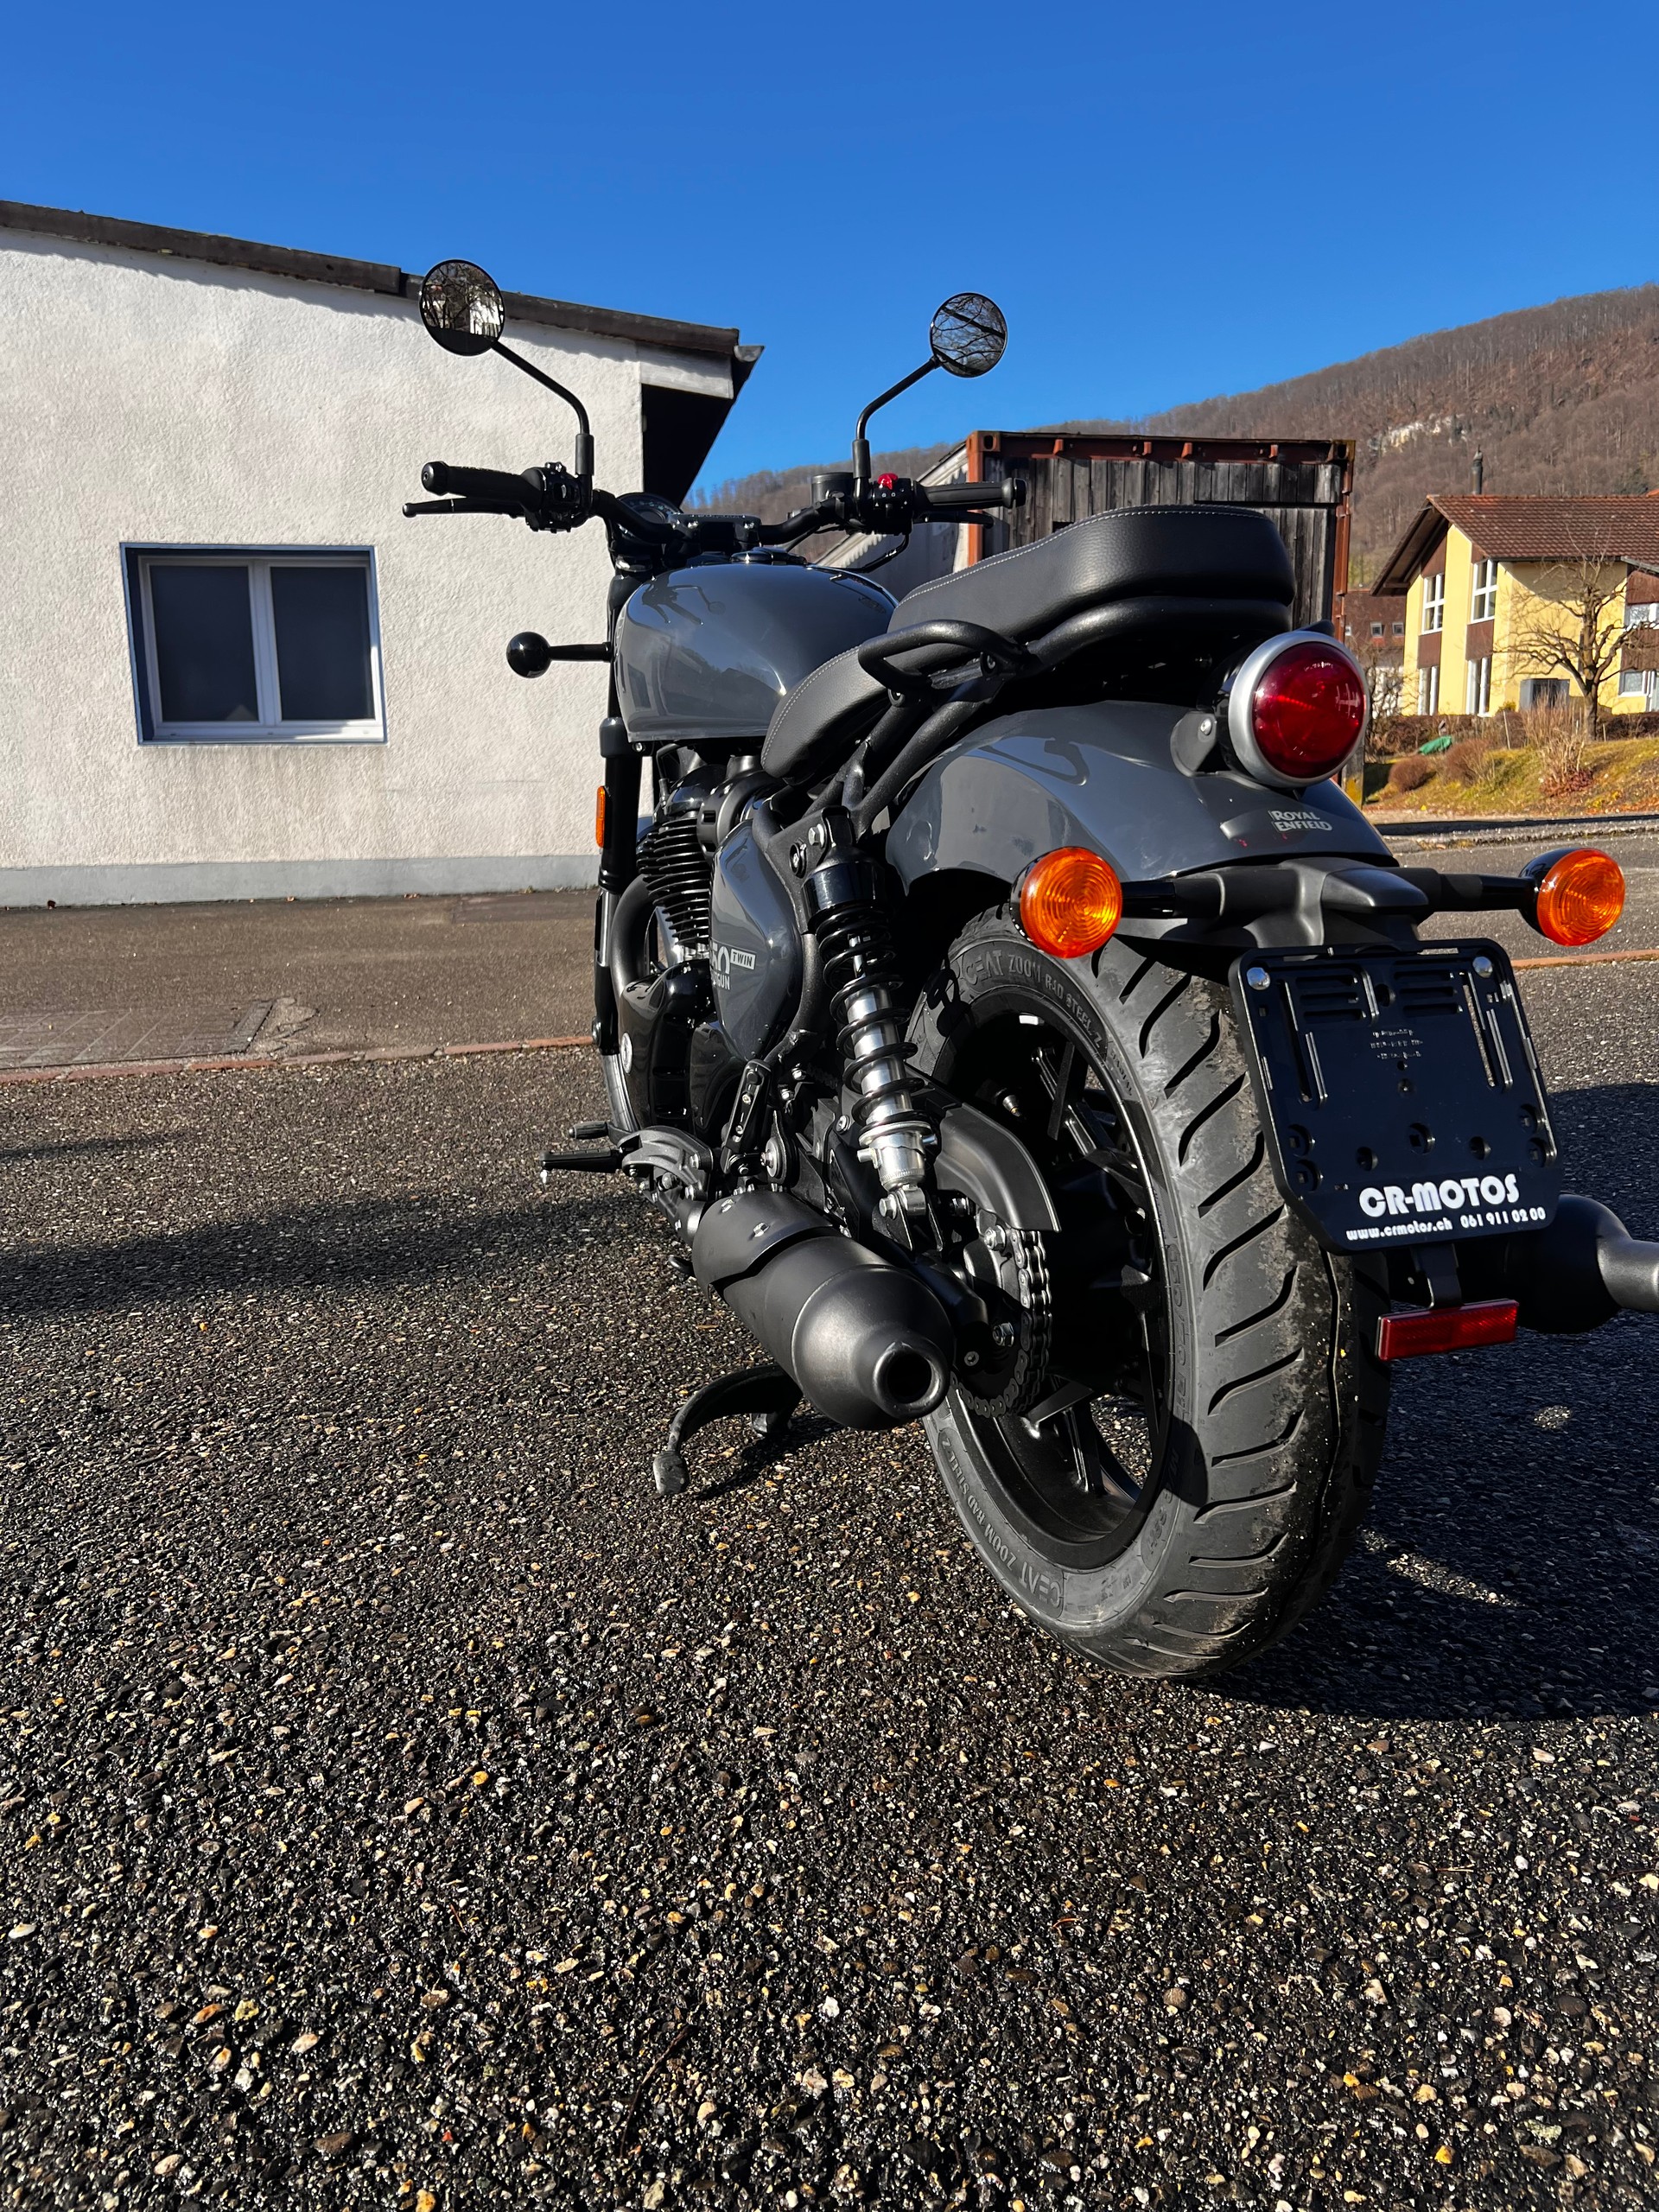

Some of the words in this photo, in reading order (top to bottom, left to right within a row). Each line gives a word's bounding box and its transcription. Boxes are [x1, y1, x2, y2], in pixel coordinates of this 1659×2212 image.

[1268, 810, 1320, 821] ROYAL
[1271, 820, 1332, 831] ENFIELD
[732, 951, 753, 967] TWIN
[965, 950, 1004, 985] CEAT
[1008, 954, 1041, 983] ZOOM
[1359, 1173, 1520, 1217] CR-MOTOS
[1345, 1217, 1452, 1241] www.crmotos.ch
[1459, 1213, 1484, 1229] 061
[1485, 1210, 1510, 1226] 911
[1511, 1209, 1528, 1223] 02
[1529, 1206, 1547, 1221] 00
[967, 1495, 987, 1527] RAD
[983, 1522, 1018, 1571] ZOOM
[1018, 1561, 1062, 1608] CEAT
